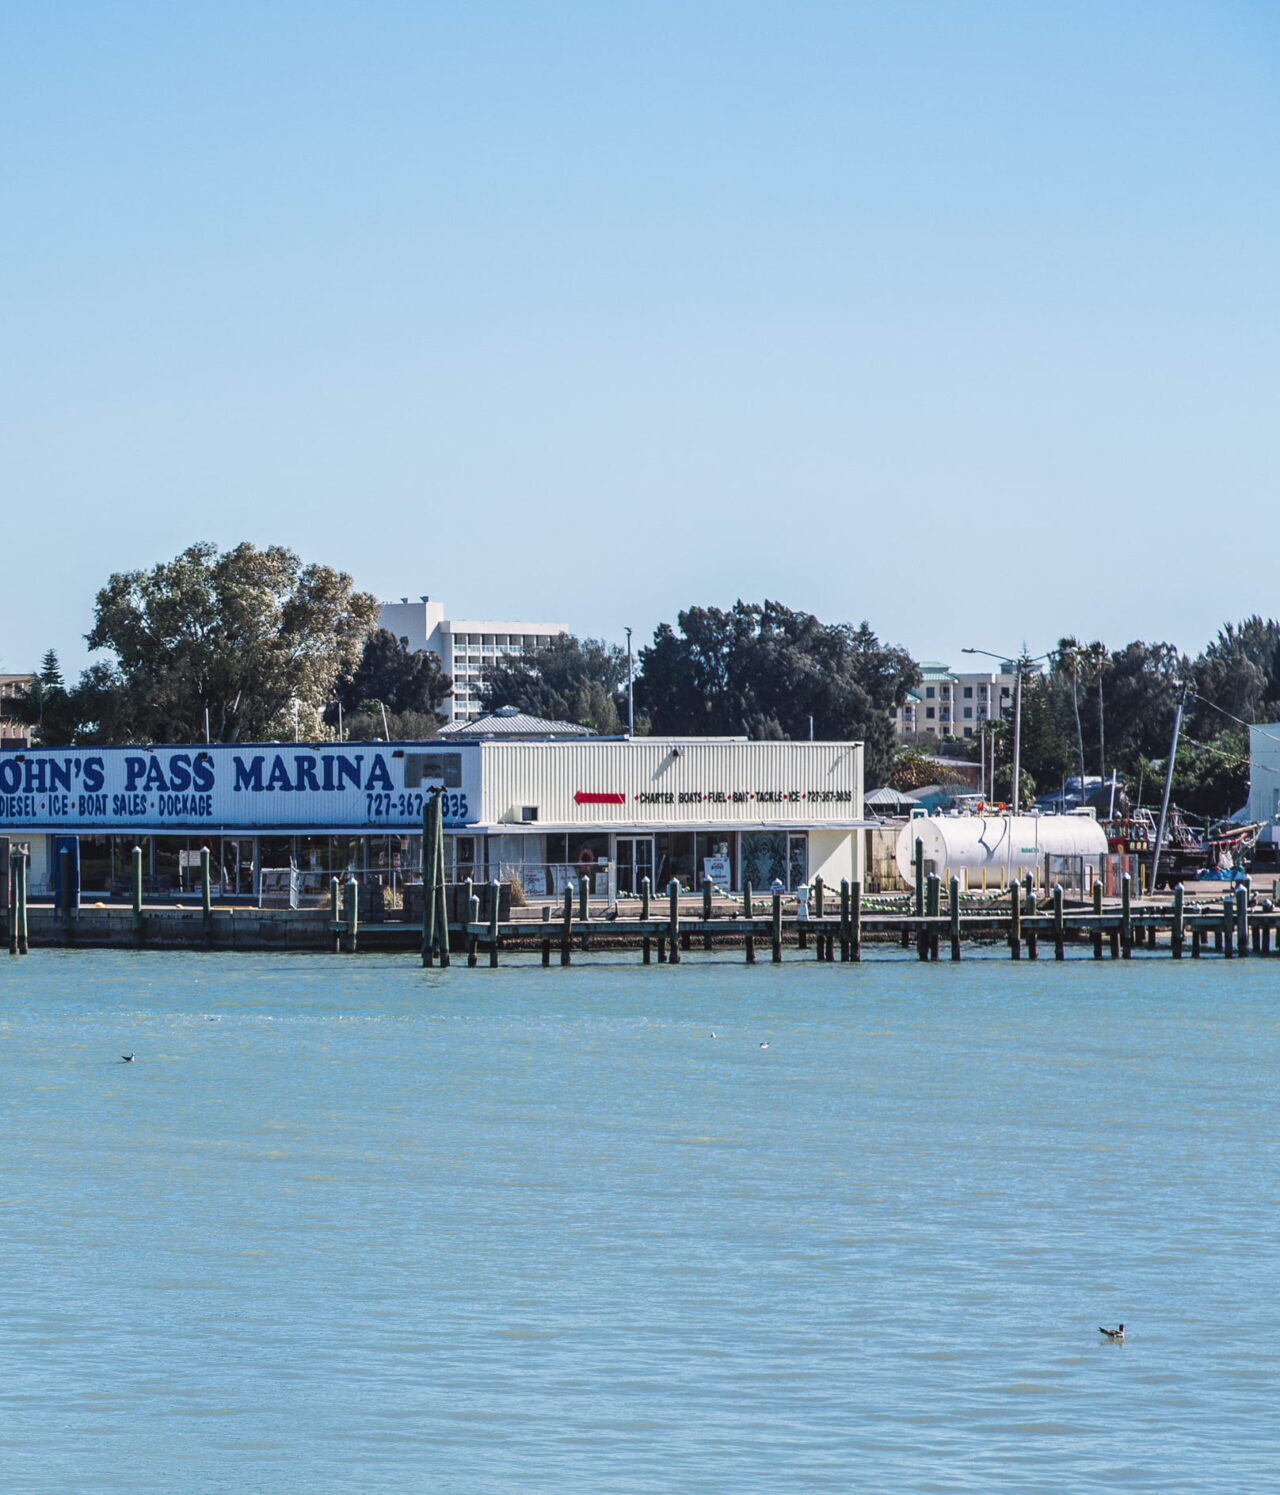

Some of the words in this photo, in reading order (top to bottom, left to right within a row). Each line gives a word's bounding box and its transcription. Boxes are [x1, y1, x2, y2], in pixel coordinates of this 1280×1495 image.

[124, 754, 215, 792] PASS
[233, 753, 394, 792] MARINA
[0, 795, 37, 818] DIESEL
[48, 794, 68, 816] ICE
[78, 794, 108, 816] BOAT
[112, 794, 147, 816] SALES
[159, 794, 213, 816] DOCKAGE
[639, 791, 675, 804] CHARTER
[678, 791, 702, 804] BOATS
[708, 791, 727, 803] FUEL
[732, 790, 750, 803] BAIT
[755, 790, 783, 803] TACKLE
[788, 790, 801, 803] ICE
